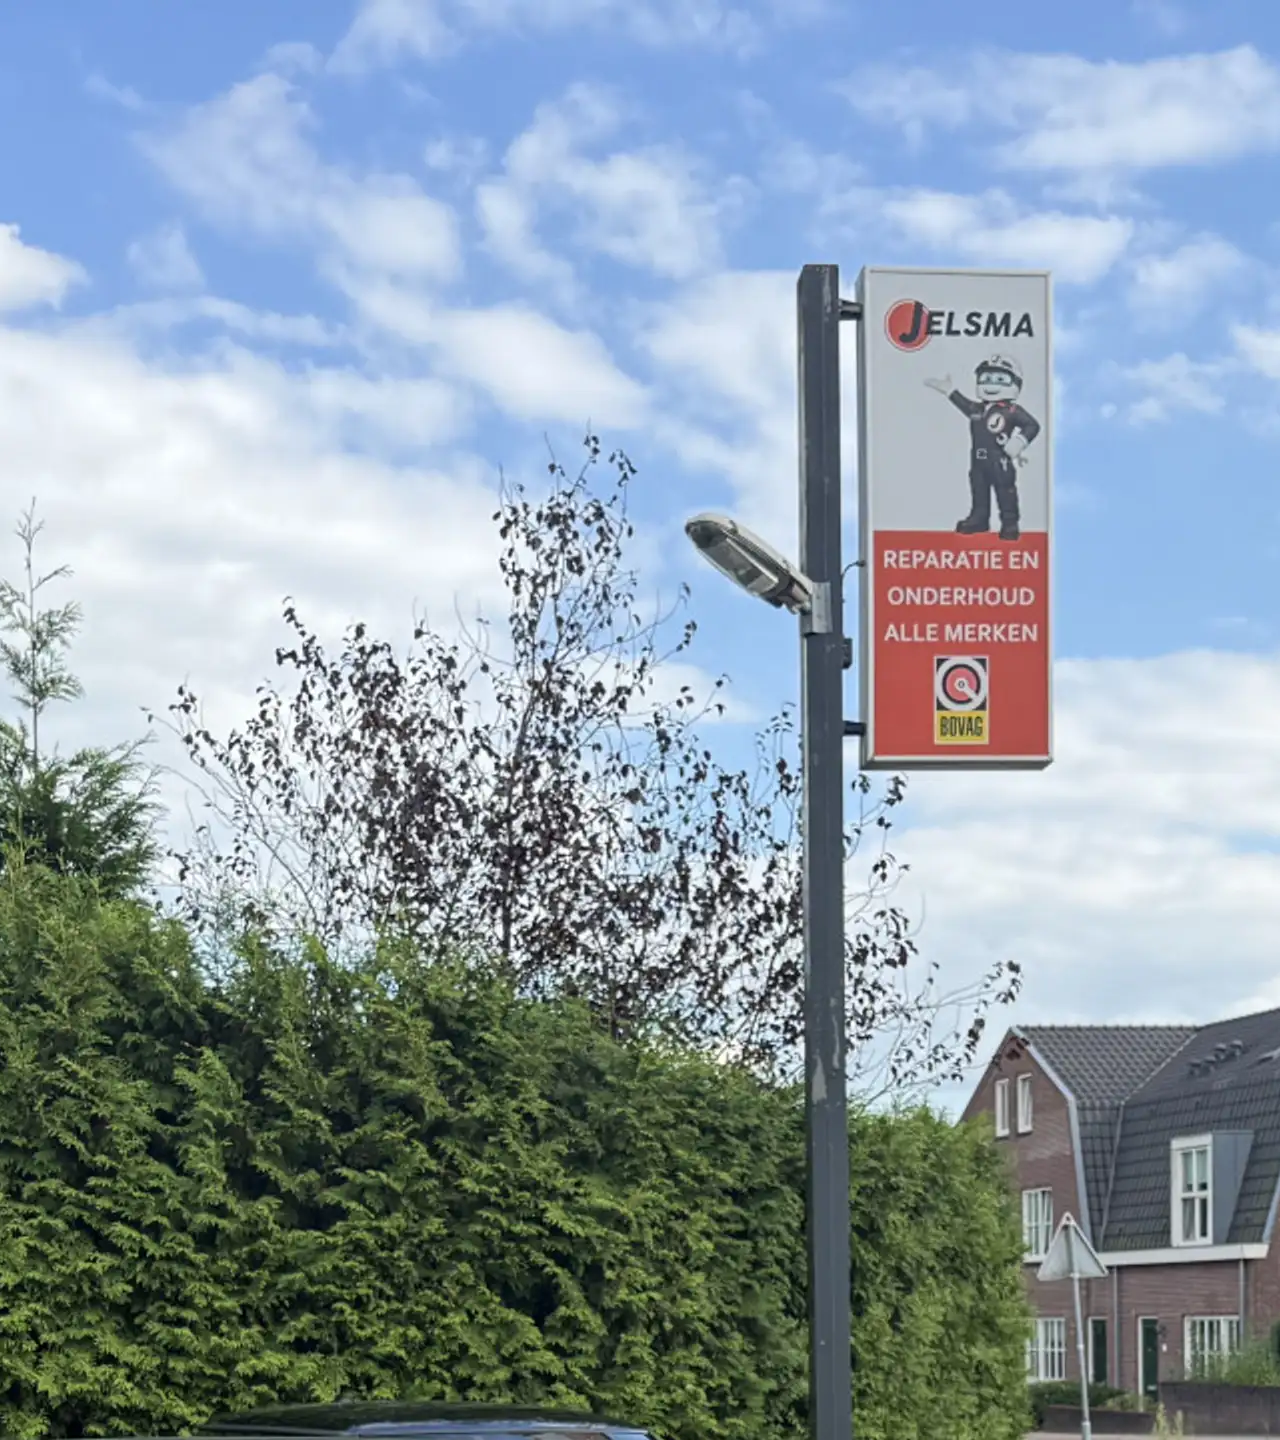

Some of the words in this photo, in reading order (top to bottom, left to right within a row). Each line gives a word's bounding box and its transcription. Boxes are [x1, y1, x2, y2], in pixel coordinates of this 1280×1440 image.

[899, 300, 1035, 343] JELSMA
[883, 549, 1004, 569] REPARATIE
[1008, 551, 1039, 570] EN
[887, 586, 1036, 607] ONDERHOUD
[884, 623, 939, 642] ALLE
[944, 623, 1038, 642] MERKEN
[939, 716, 984, 737] BOVAG
